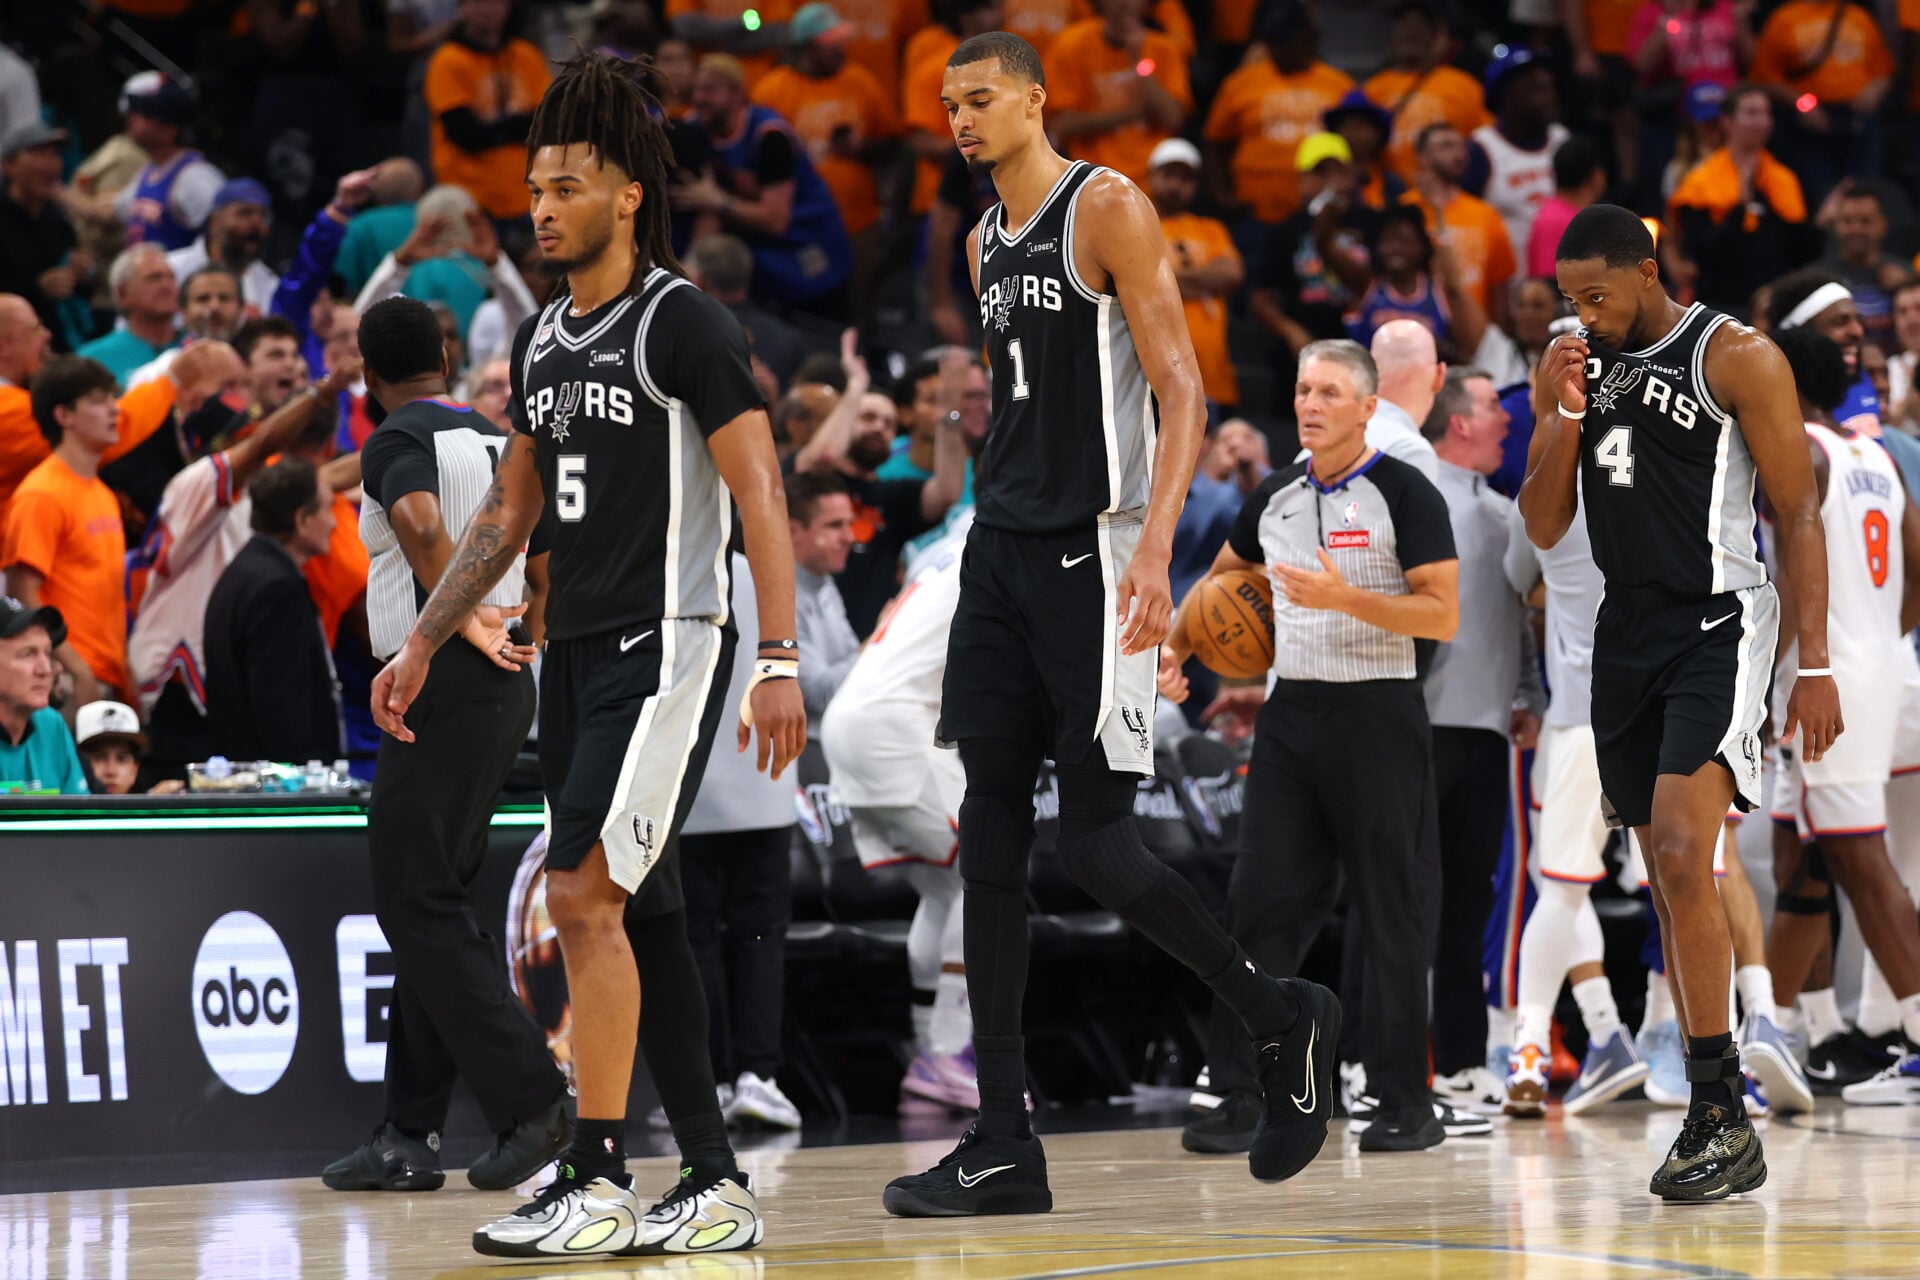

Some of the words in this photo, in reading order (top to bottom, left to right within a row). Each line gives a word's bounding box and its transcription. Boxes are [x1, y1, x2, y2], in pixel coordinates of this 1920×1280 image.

[1030, 243, 1054, 253] LEDGER
[980, 275, 1062, 333] SPURS
[593, 353, 620, 363] LEDGER
[1007, 338, 1030, 401] 1
[1647, 362, 1679, 376] LEDGER
[525, 381, 634, 443] SPURS
[1594, 425, 1635, 488] 4
[556, 454, 587, 522] 5
[1329, 533, 1369, 546] Emirates
[1863, 508, 1889, 588] 8
[202, 966, 289, 1027] abc
